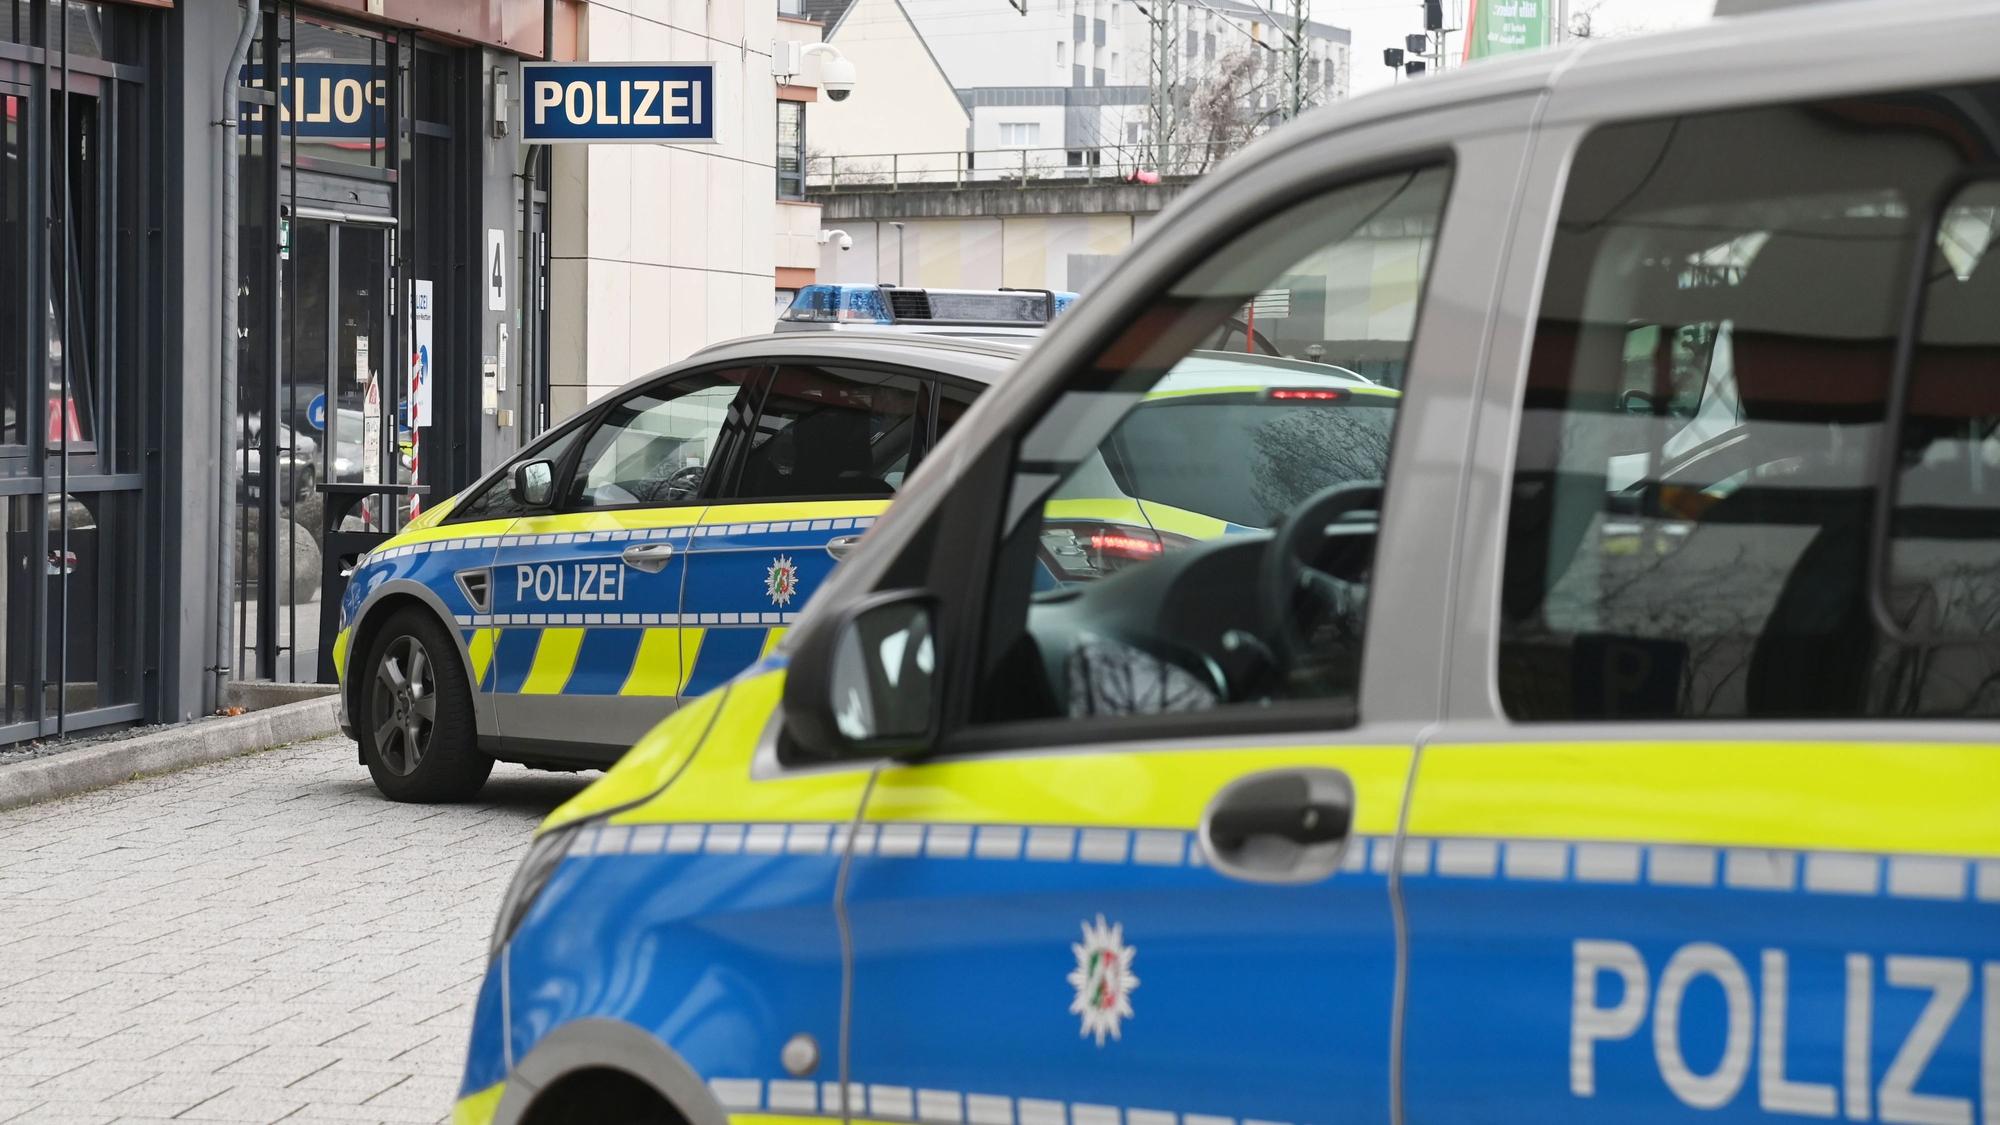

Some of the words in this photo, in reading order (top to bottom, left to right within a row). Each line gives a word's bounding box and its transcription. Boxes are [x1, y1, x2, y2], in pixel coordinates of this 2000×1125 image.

[534, 80, 702, 125] POLIZEI
[492, 242, 503, 298] 4
[516, 563, 625, 602] POLIZEI
[1569, 938, 2000, 1125] POLIZ
